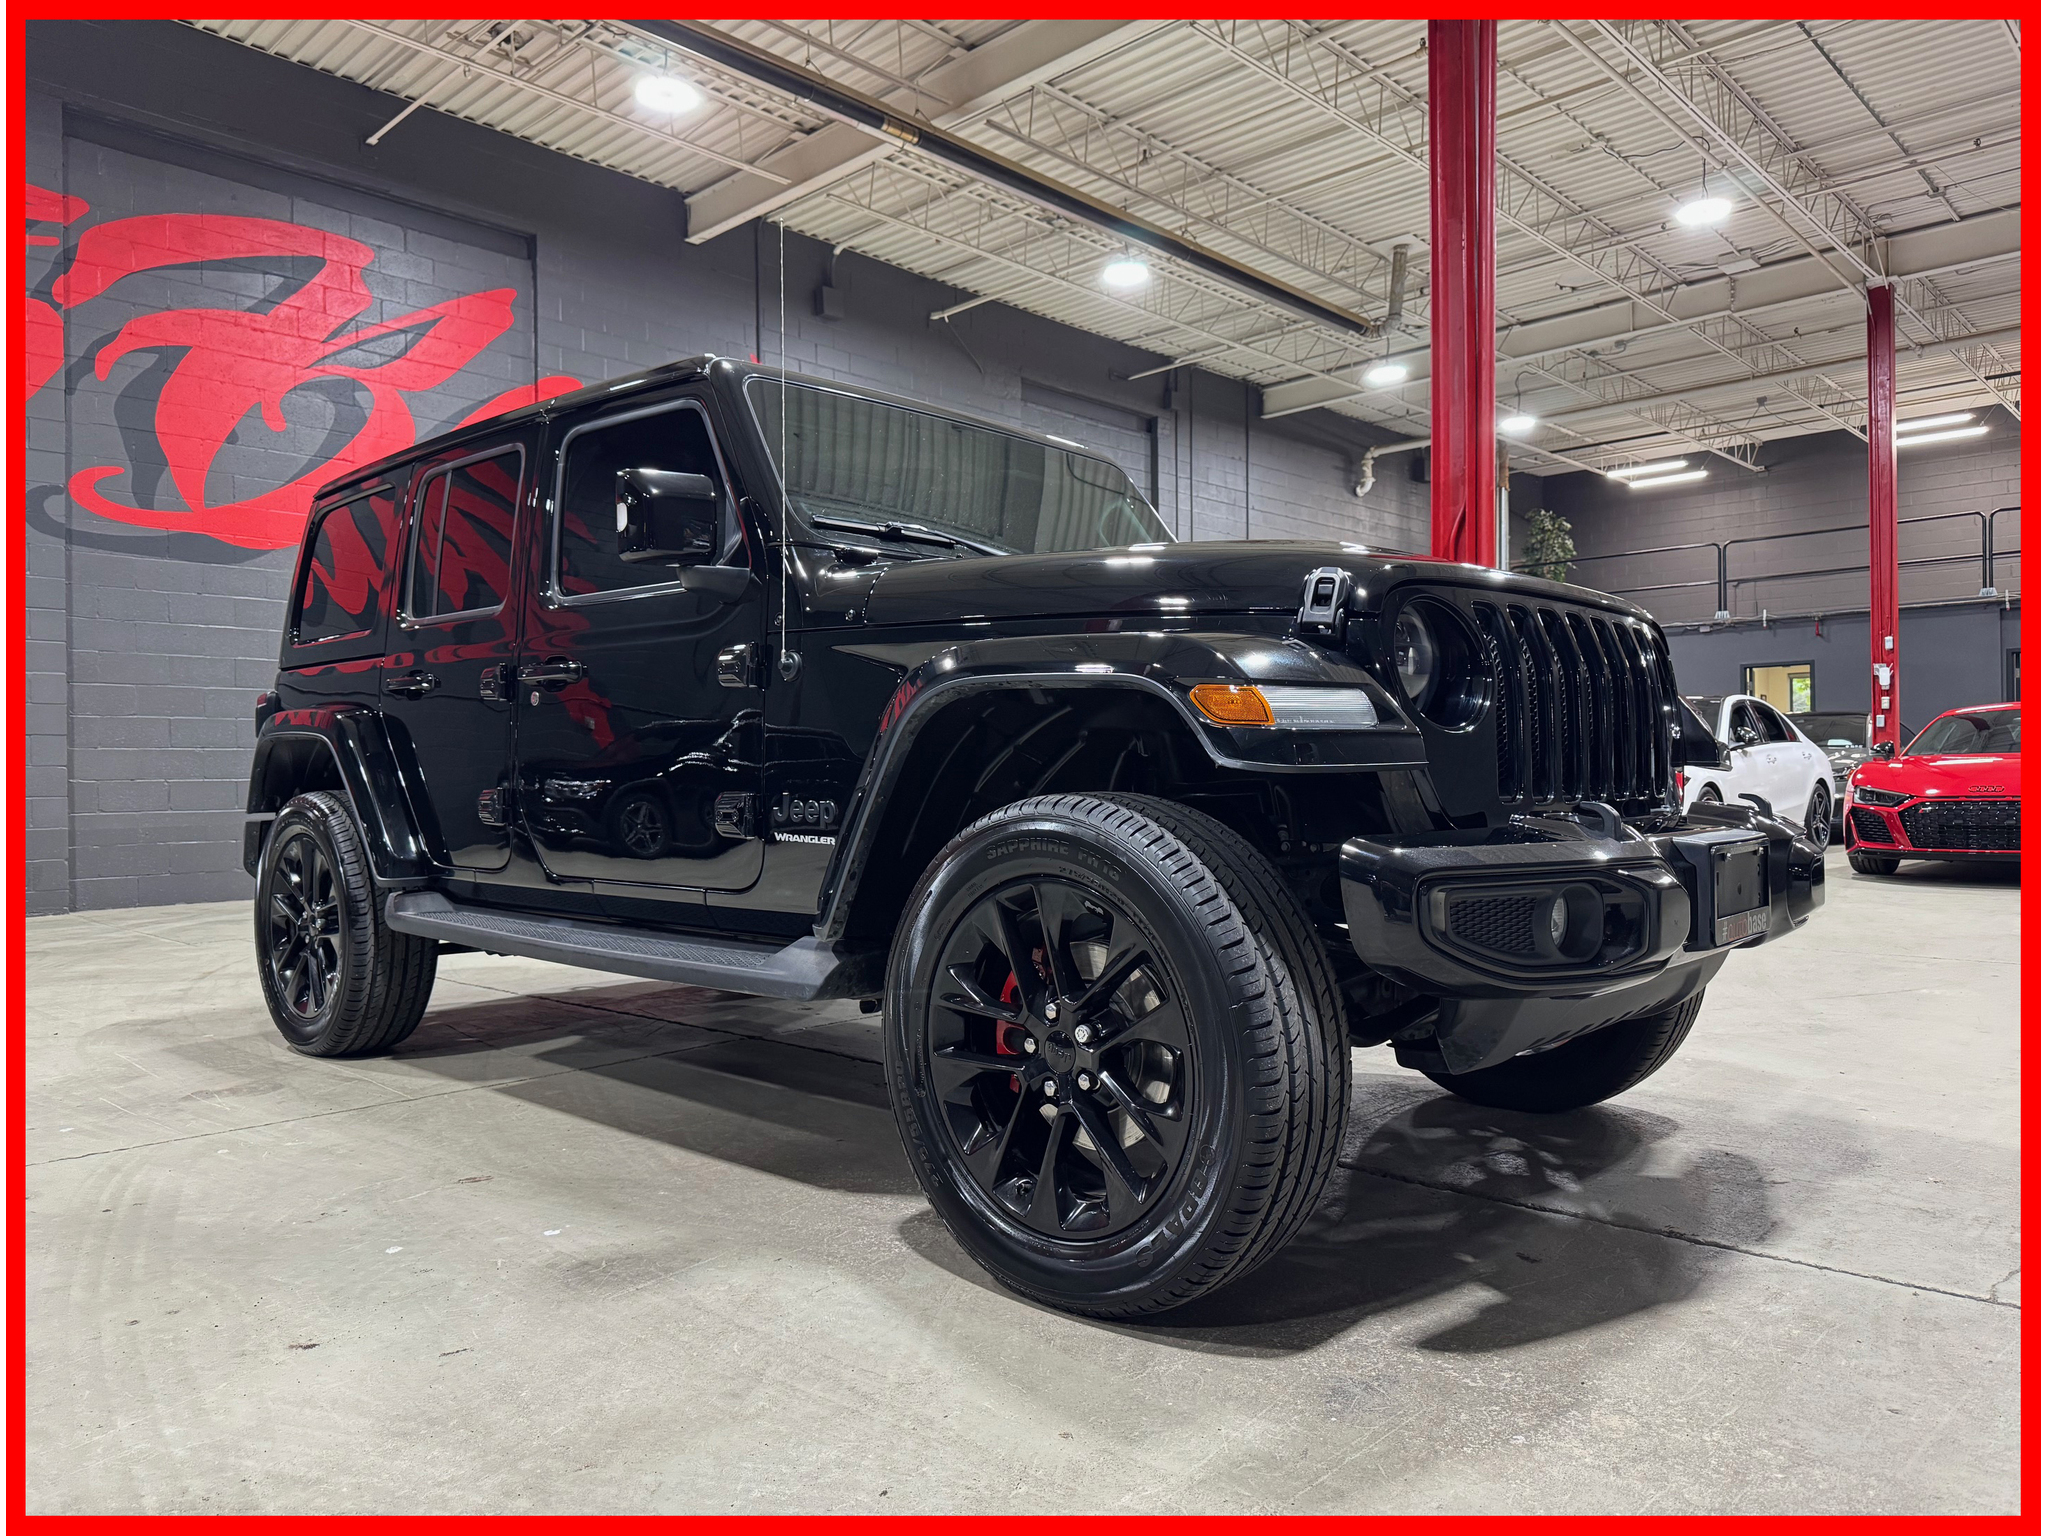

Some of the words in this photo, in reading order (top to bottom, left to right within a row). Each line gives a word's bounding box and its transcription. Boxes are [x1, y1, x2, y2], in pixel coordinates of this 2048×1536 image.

[773, 792, 838, 828] Jeep
[774, 832, 836, 846] WRANGLER
[985, 837, 1070, 860] SAPPHIRE
